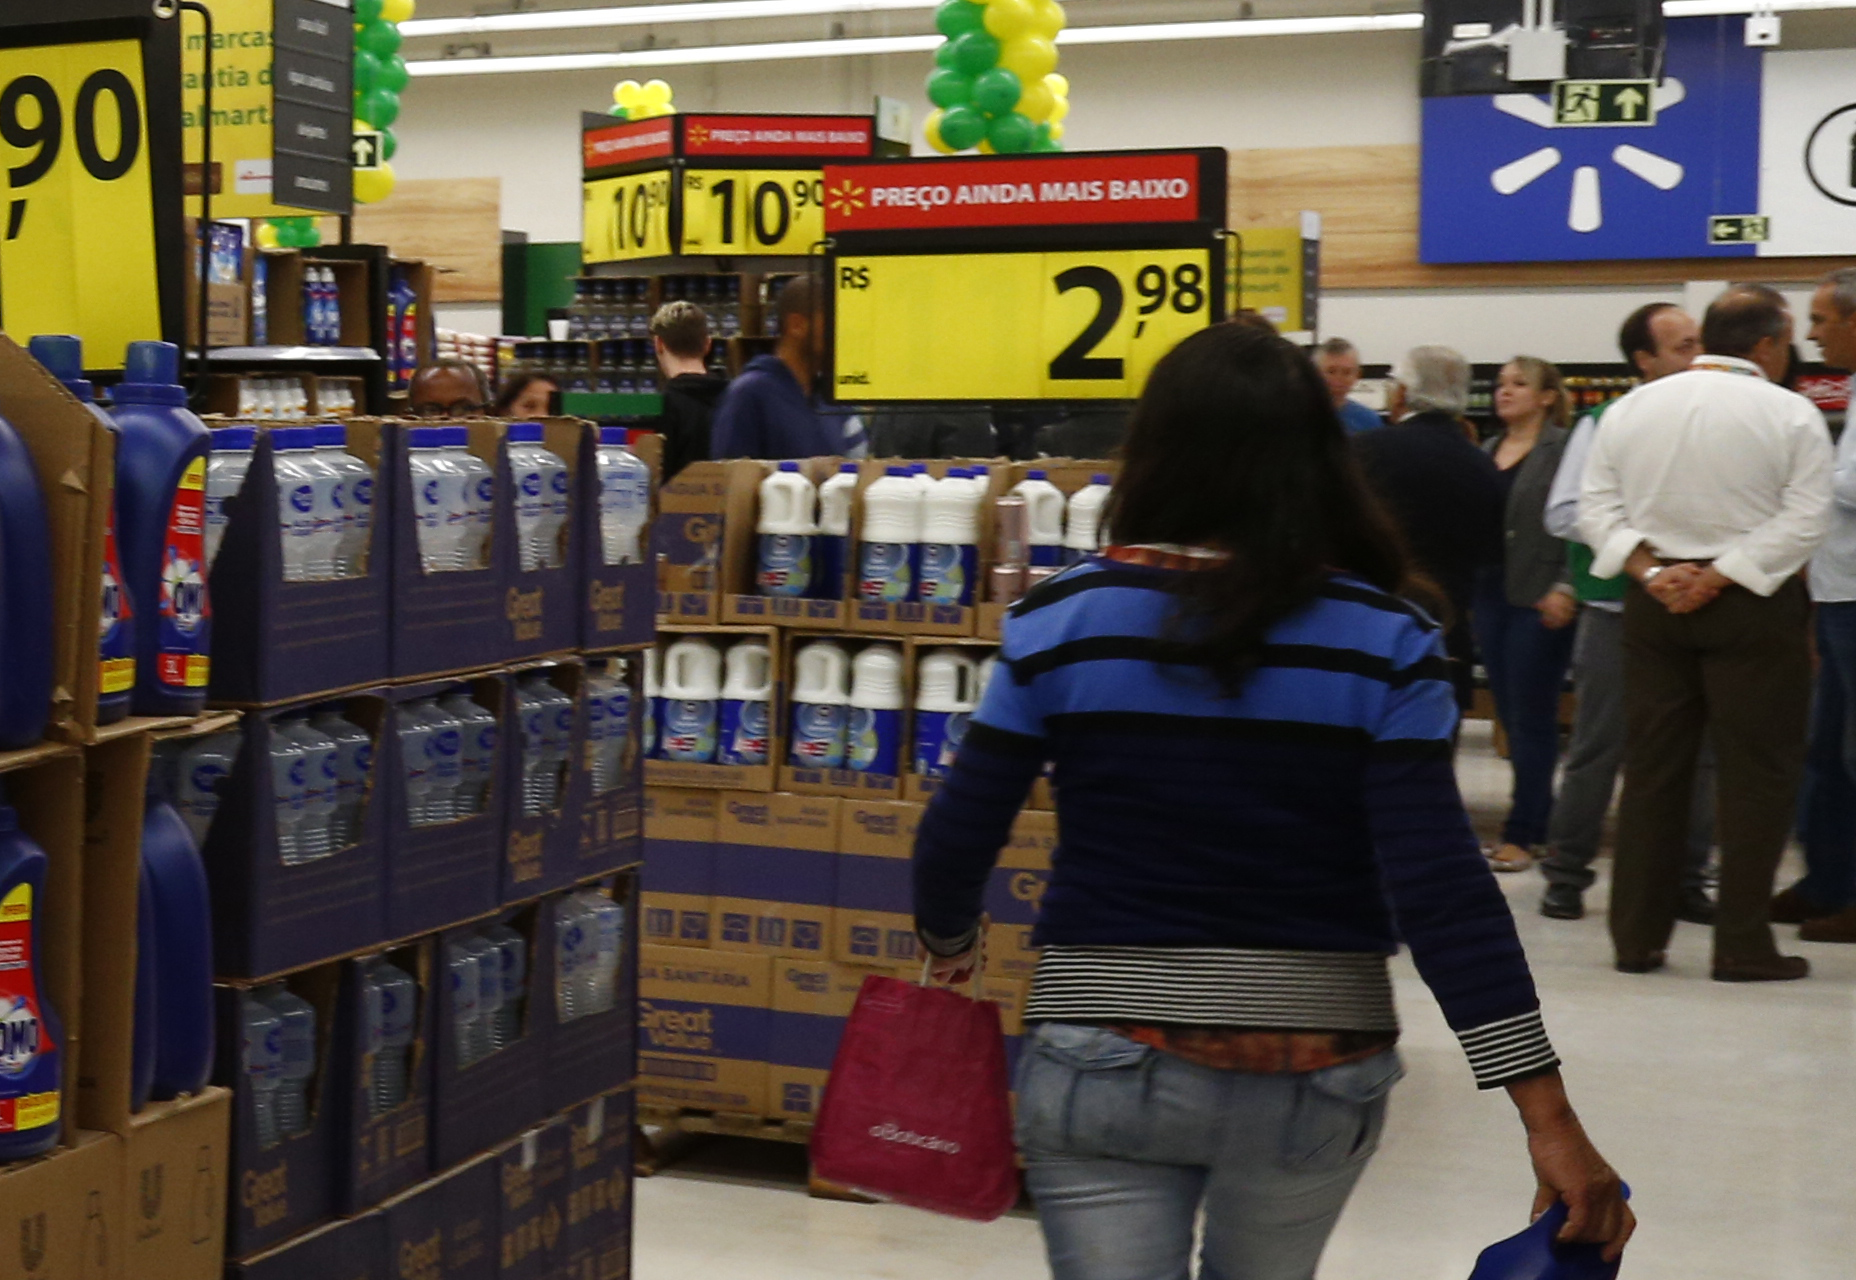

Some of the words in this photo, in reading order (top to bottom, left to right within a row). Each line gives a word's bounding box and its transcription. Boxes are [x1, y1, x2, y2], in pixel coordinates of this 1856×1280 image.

[871, 186, 949, 212] PREÇO
[955, 183, 1034, 206] AINDA
[1040, 179, 1105, 203] MAIS
[1110, 177, 1189, 201] BAIXO
[840, 265, 870, 291] R$
